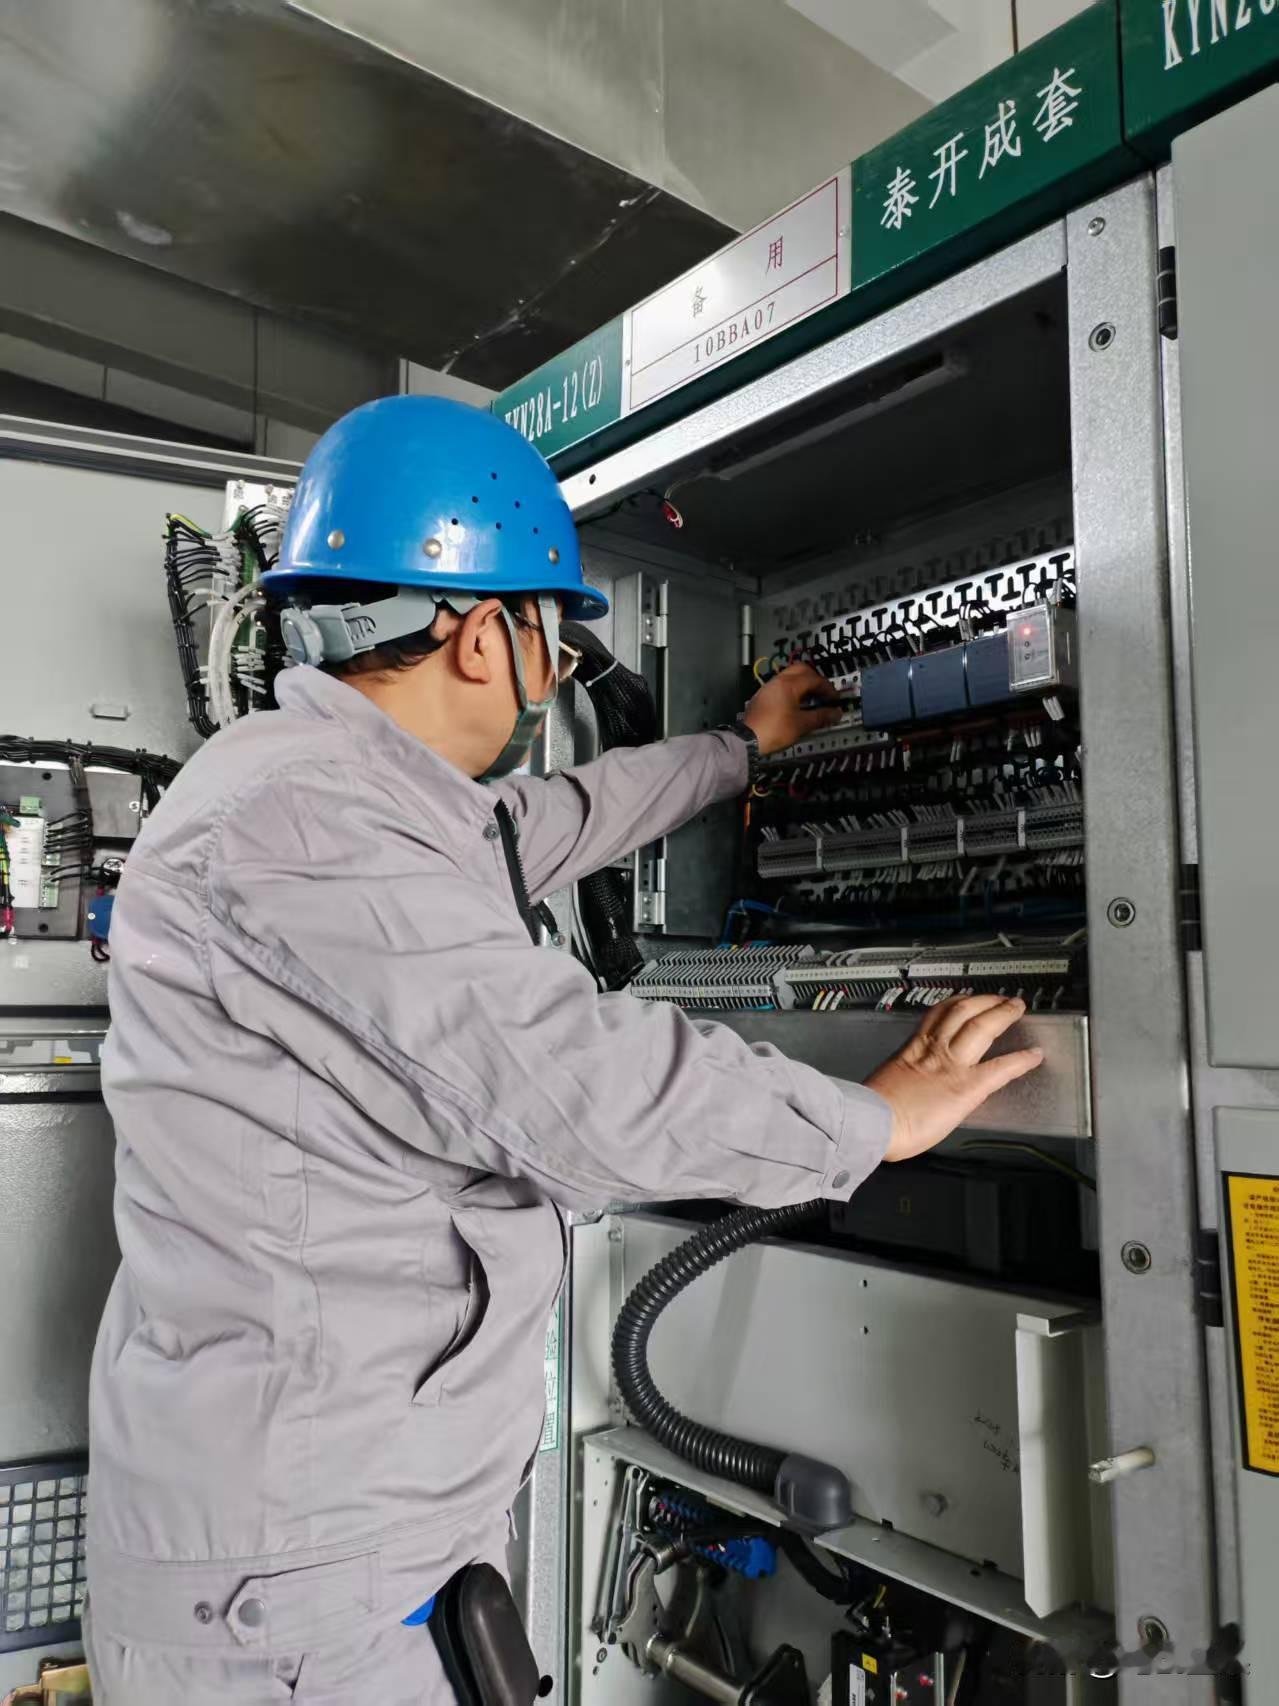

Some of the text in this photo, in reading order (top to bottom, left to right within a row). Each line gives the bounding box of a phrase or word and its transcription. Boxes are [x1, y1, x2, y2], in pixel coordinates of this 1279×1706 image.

[880, 67, 1082, 229] 泰开成套
[694, 301, 775, 364] 10BBA07
